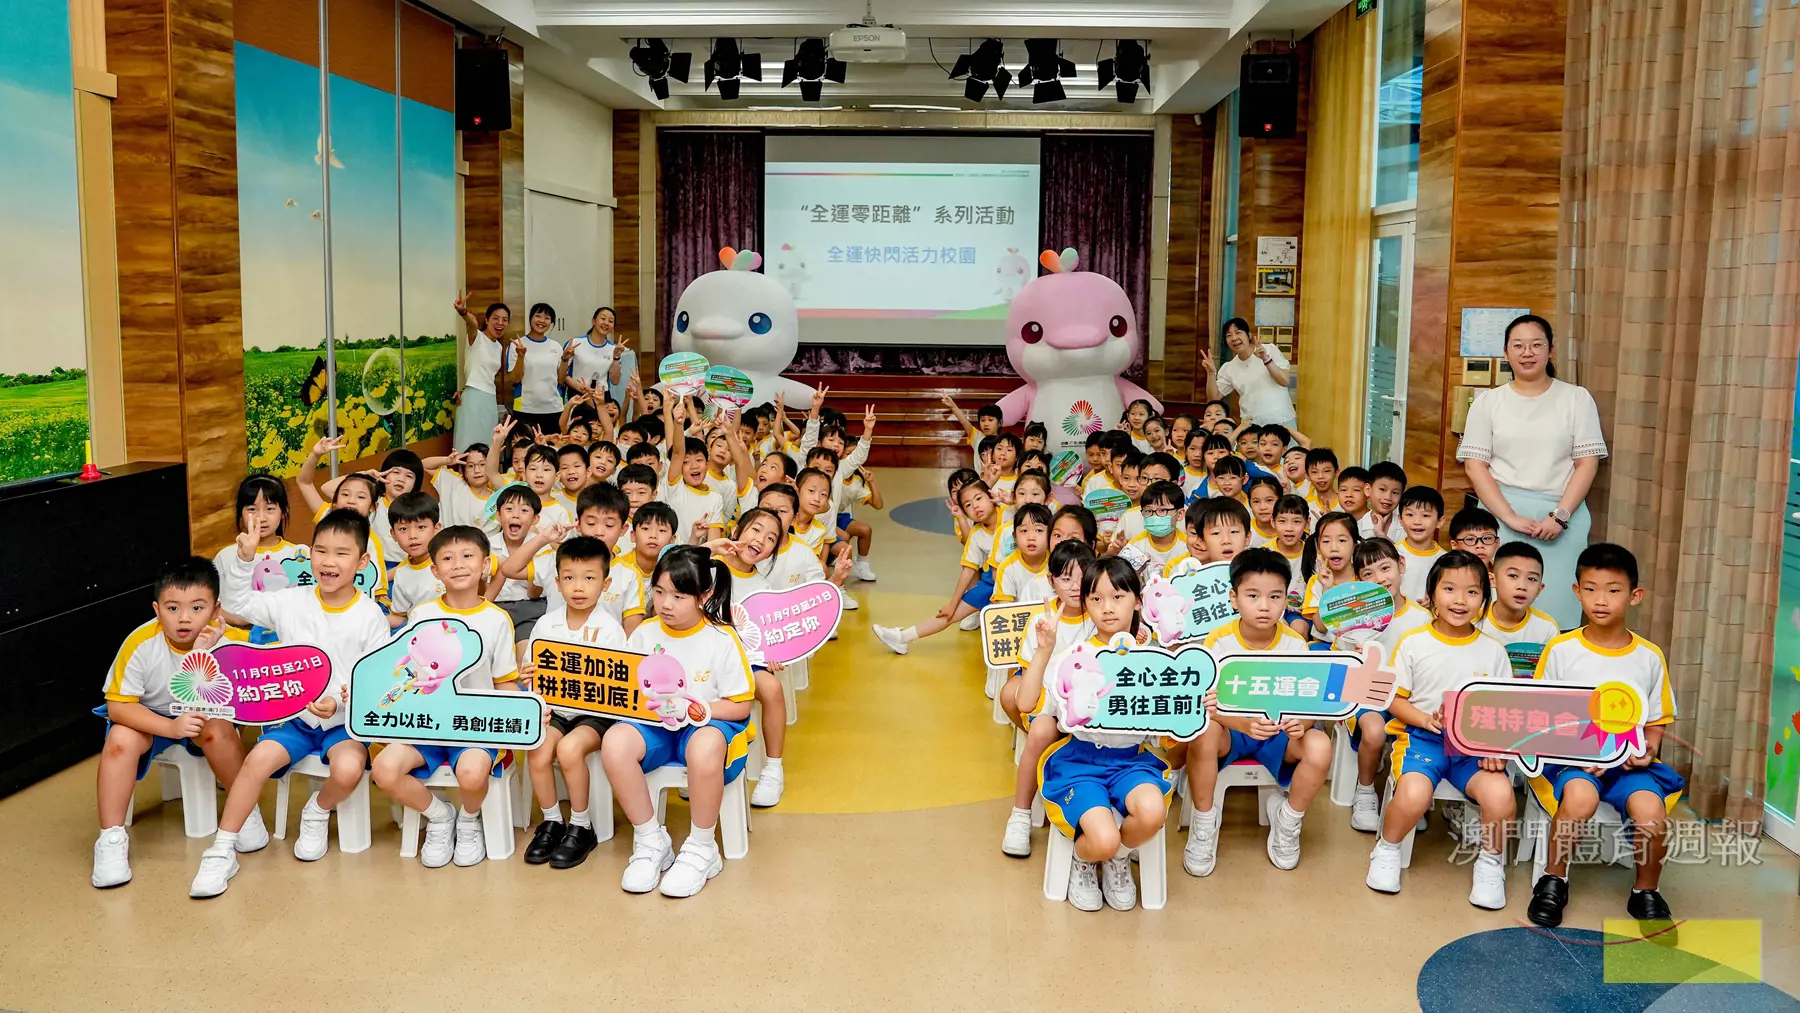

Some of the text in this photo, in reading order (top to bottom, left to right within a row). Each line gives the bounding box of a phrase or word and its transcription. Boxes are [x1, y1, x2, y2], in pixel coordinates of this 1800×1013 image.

[853, 34, 880, 42] EPSON
[827, 246, 977, 265] 全運快閃活力校園
[760, 590, 833, 626] 11月9日至21日
[764, 615, 821, 646] 約定你
[232, 655, 324, 681] 11月9日至21日
[537, 647, 629, 683] 全運加油
[1115, 666, 1201, 688] 全心全力
[236, 679, 306, 704] 約定你
[1224, 674, 1321, 698] 十五運會
